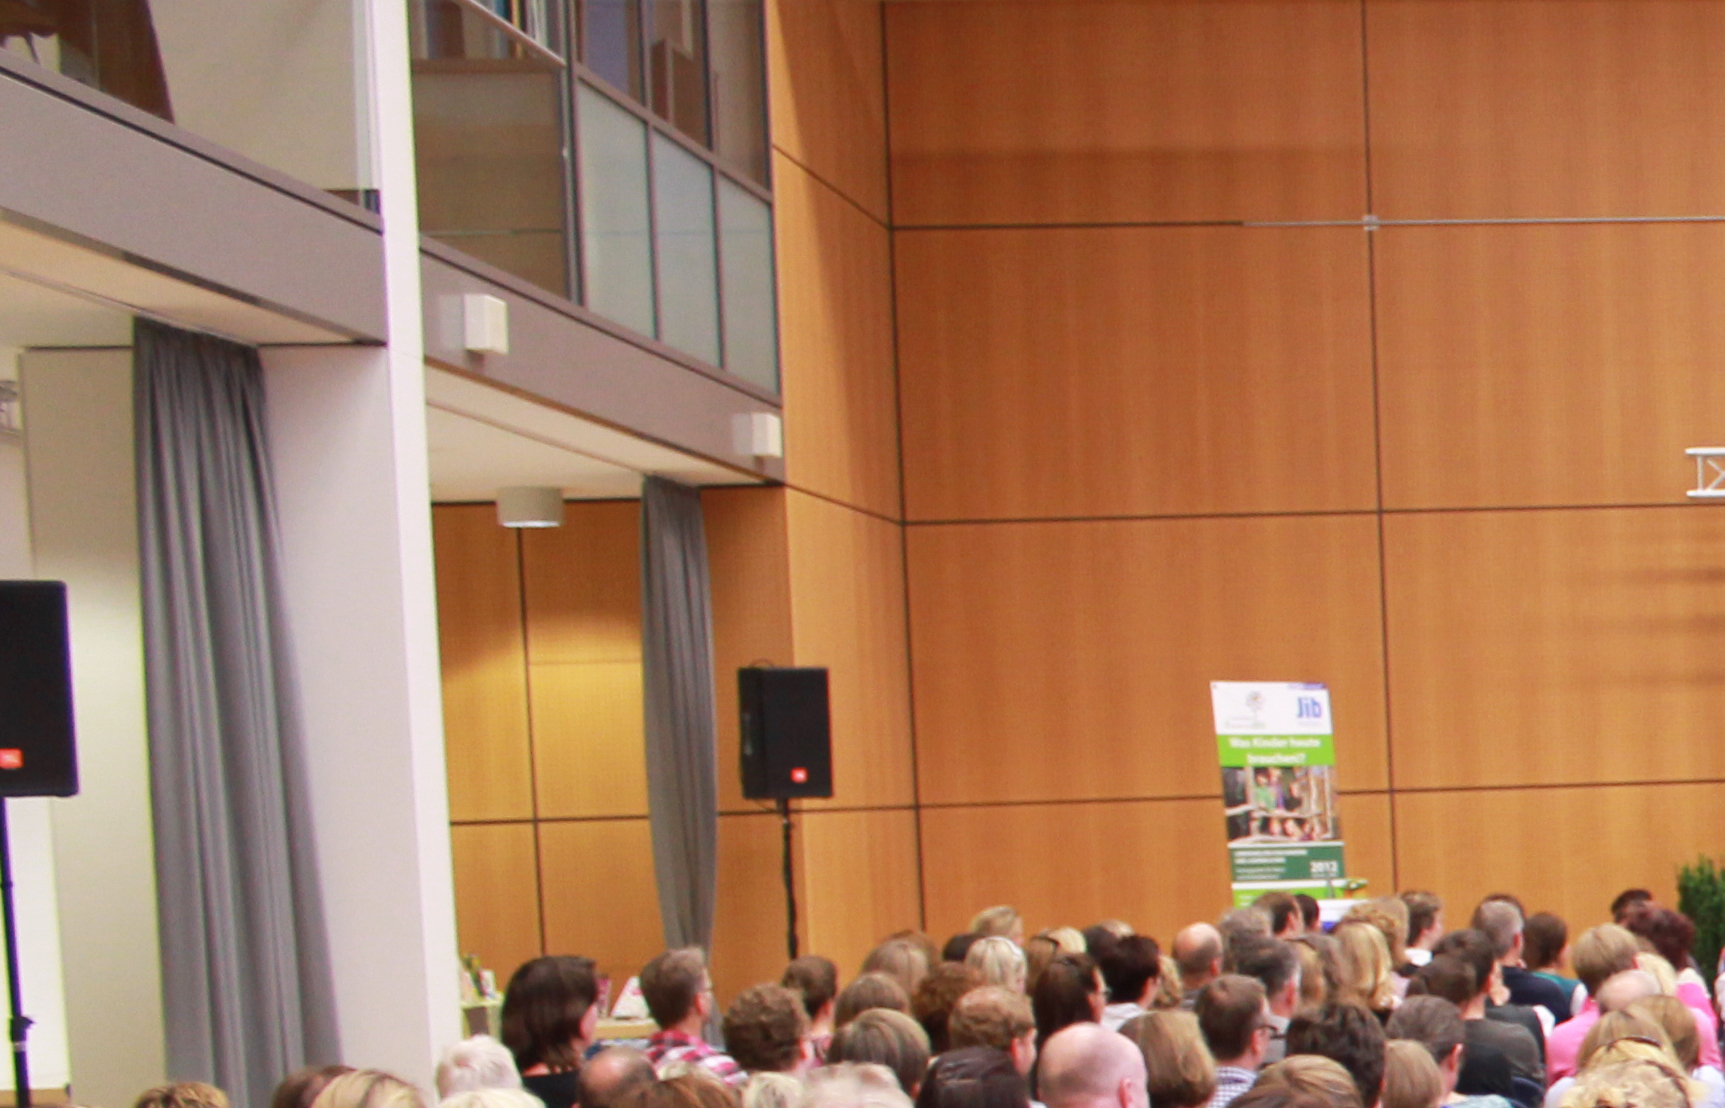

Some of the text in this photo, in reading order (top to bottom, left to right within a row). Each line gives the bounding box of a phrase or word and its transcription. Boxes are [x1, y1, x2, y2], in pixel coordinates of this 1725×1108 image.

[1297, 697, 1322, 718] Jib
[1228, 737, 1321, 748] Was Kinder heute
